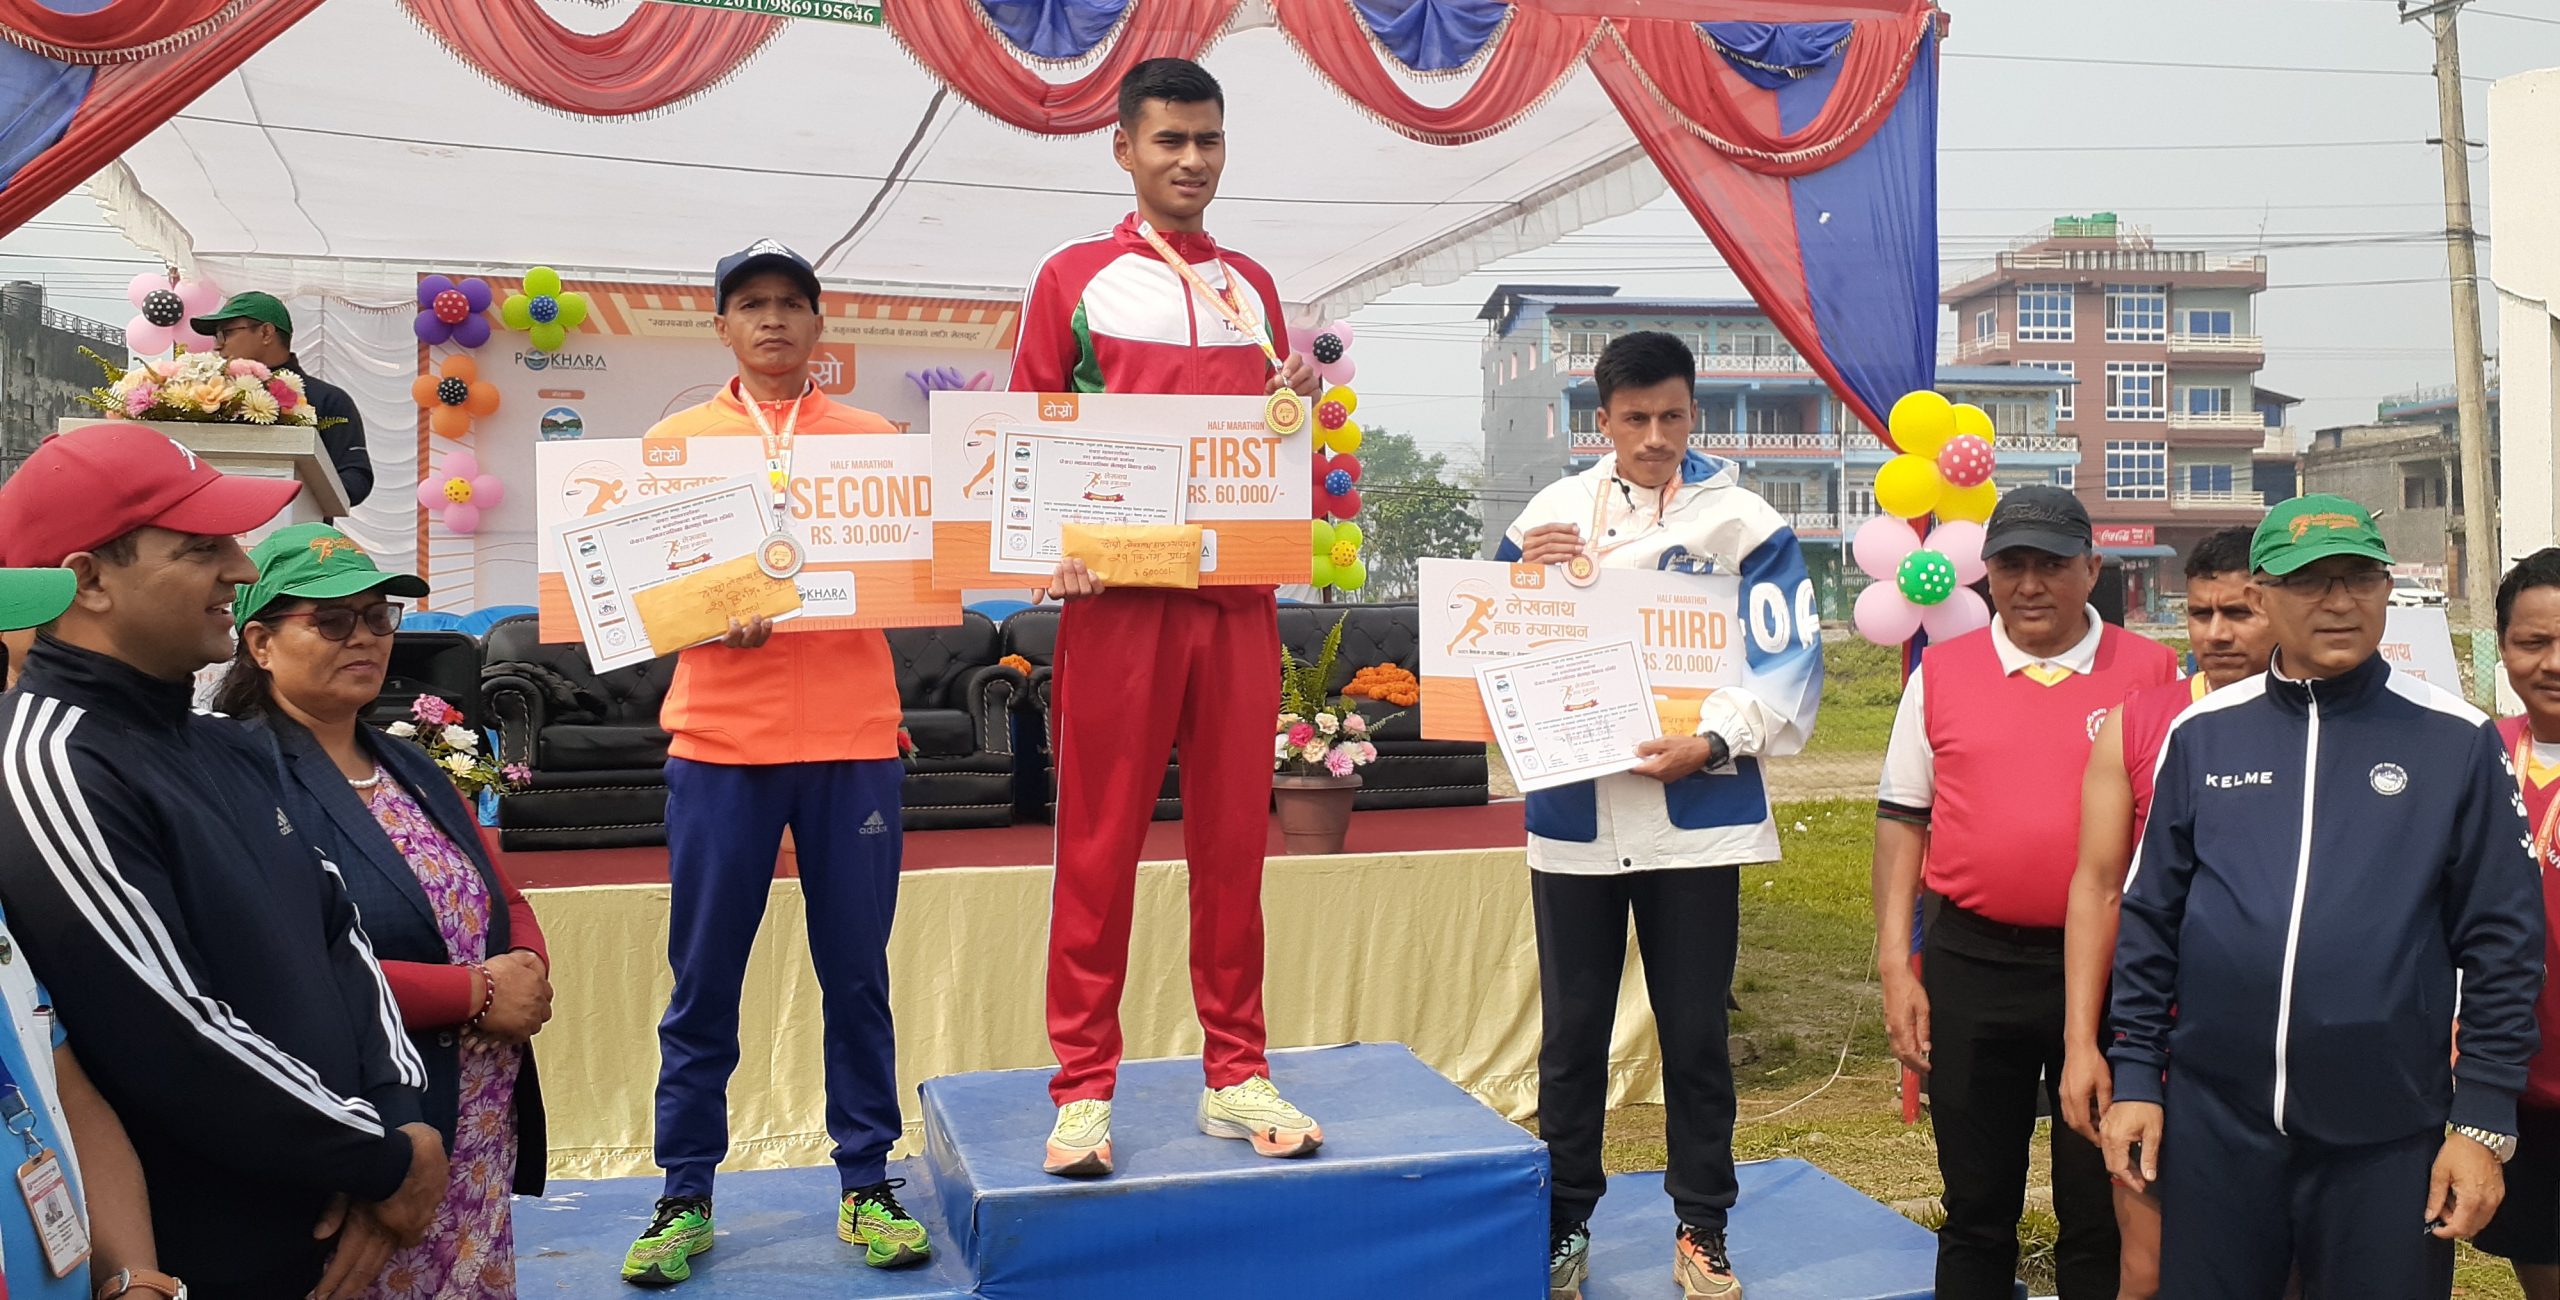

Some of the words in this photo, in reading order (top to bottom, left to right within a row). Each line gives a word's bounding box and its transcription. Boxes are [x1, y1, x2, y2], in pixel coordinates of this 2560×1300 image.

[1207, 421, 1226, 431] HALF
[1226, 421, 1265, 431] MARATHON
[830, 460, 849, 470] HALF
[851, 460, 893, 469] MARATHON
[1190, 437, 1282, 479] FIRST
[791, 476, 931, 519] SECOND
[1188, 484, 1211, 503] RS.
[1215, 484, 1286, 505] 60,000/-
[811, 526, 837, 545] RS.
[842, 524, 919, 547] 30,000/-
[1505, 593, 1576, 617] लेखनाथ
[1656, 594, 1672, 603] HALF
[1673, 595, 1707, 605] MARATHON
[1493, 621, 1520, 636] हाफ
[1526, 622, 1589, 638] म्याराथन
[1638, 608, 1727, 650] THIRD
[1665, 654, 1728, 674] 20,000/-
[2205, 771, 2273, 789] KELME
